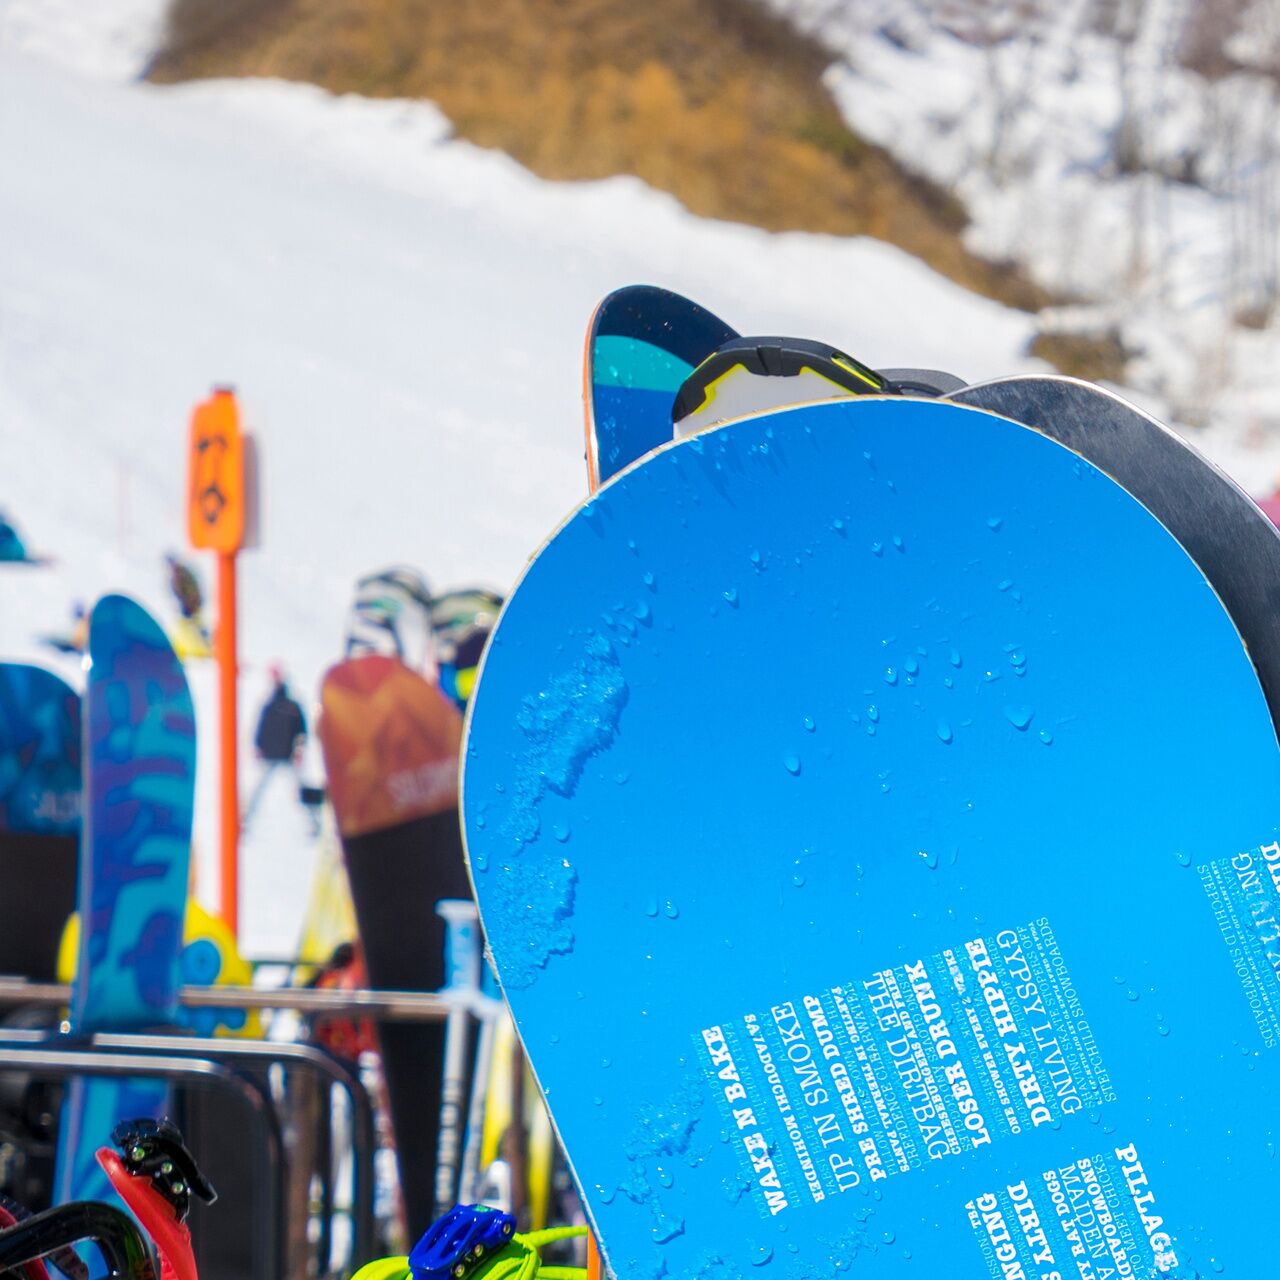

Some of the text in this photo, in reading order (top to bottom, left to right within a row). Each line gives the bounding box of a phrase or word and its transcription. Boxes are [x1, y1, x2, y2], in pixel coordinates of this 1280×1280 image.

[860, 971, 951, 1163] THE DIRTBAG
[882, 968, 961, 1156] CHEESEBURGERS AND FRIES
[903, 958, 991, 1150] LOSER DRUNK
[964, 1006, 988, 1050] EVERY
[964, 937, 1052, 1128] DIRTY HIPPIE
[994, 927, 1083, 1117] GYPSY LIVING
[1034, 916, 1116, 1103] STEPCHILD SNOWBOARDS
[702, 1024, 790, 1215] WAKE N BAKE
[770, 1000, 862, 1192] UP IN SMOKE
[802, 991, 887, 1182] PRE SHRED DUMP
[981, 1051, 1010, 1106] SHOWER
[1003, 1107, 1021, 1135] ONE
[783, 1114, 825, 1202] MOHINDER
[963, 1200, 982, 1229] TBA
[1041, 1169, 1070, 1216] DOGS
[1057, 1163, 1107, 1260] MAIDEN
[1113, 1142, 1180, 1273] PILLAGE
[1005, 1180, 1054, 1269] DIRTY
[1059, 1217, 1085, 1257] RAT
